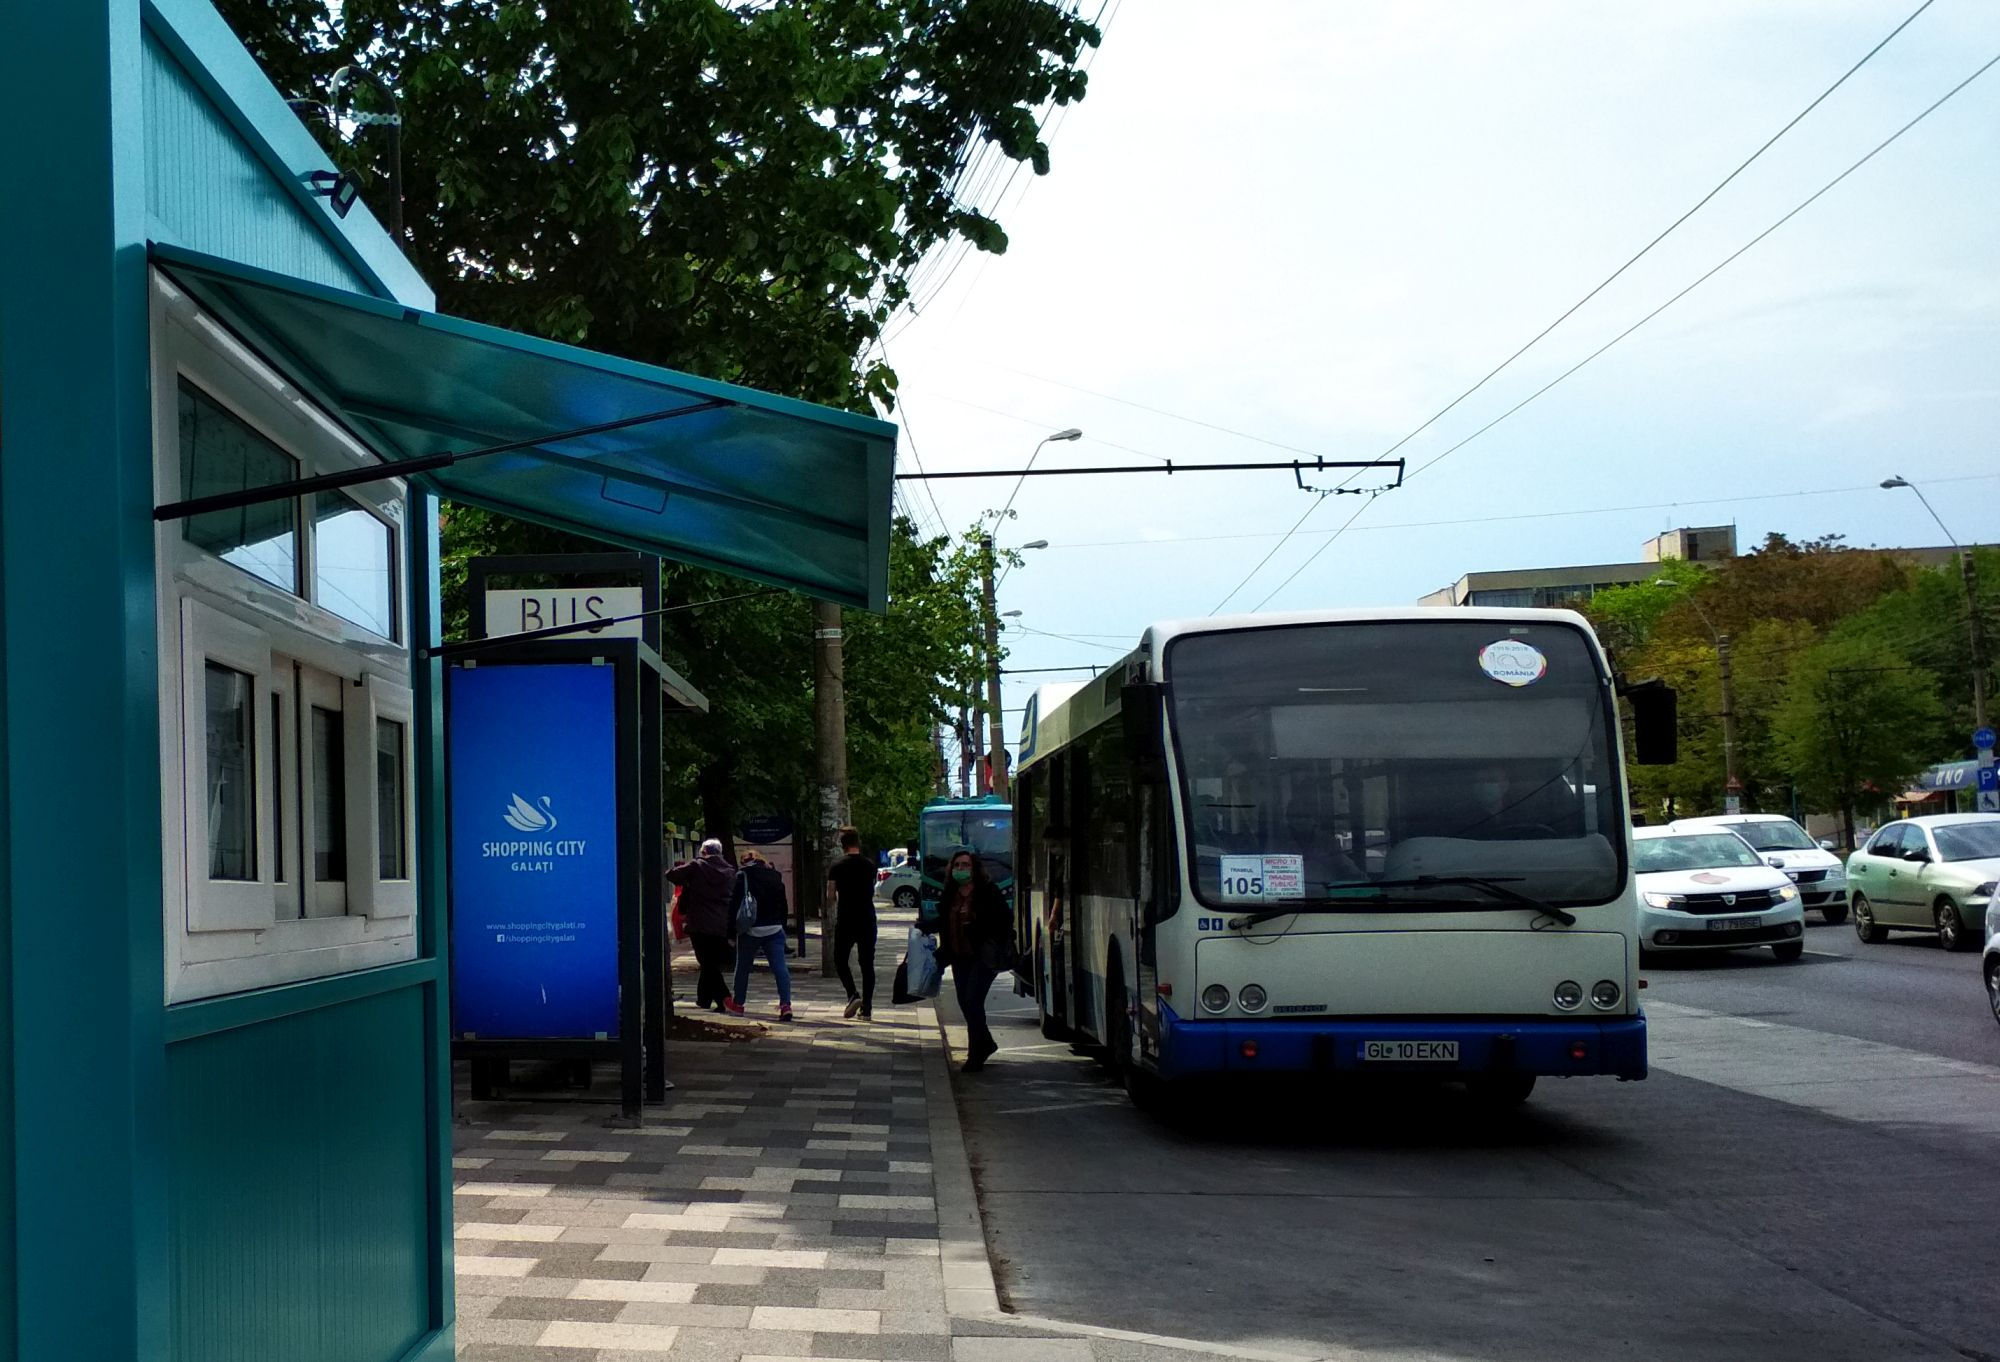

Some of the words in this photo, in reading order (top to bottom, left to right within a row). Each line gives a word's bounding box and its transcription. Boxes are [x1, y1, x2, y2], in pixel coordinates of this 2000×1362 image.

[521, 596, 604, 633] BUS
[1981, 771, 1992, 785] P
[482, 841, 553, 857] SHOPPING
[556, 840, 586, 856] CITY
[1223, 877, 1263, 895] 105
[486, 921, 586, 931] www.shoppingcitygalati.ro
[1368, 1043, 1391, 1058] GL
[1397, 1043, 1413, 1058] 10
[1417, 1043, 1455, 1058] EKN
